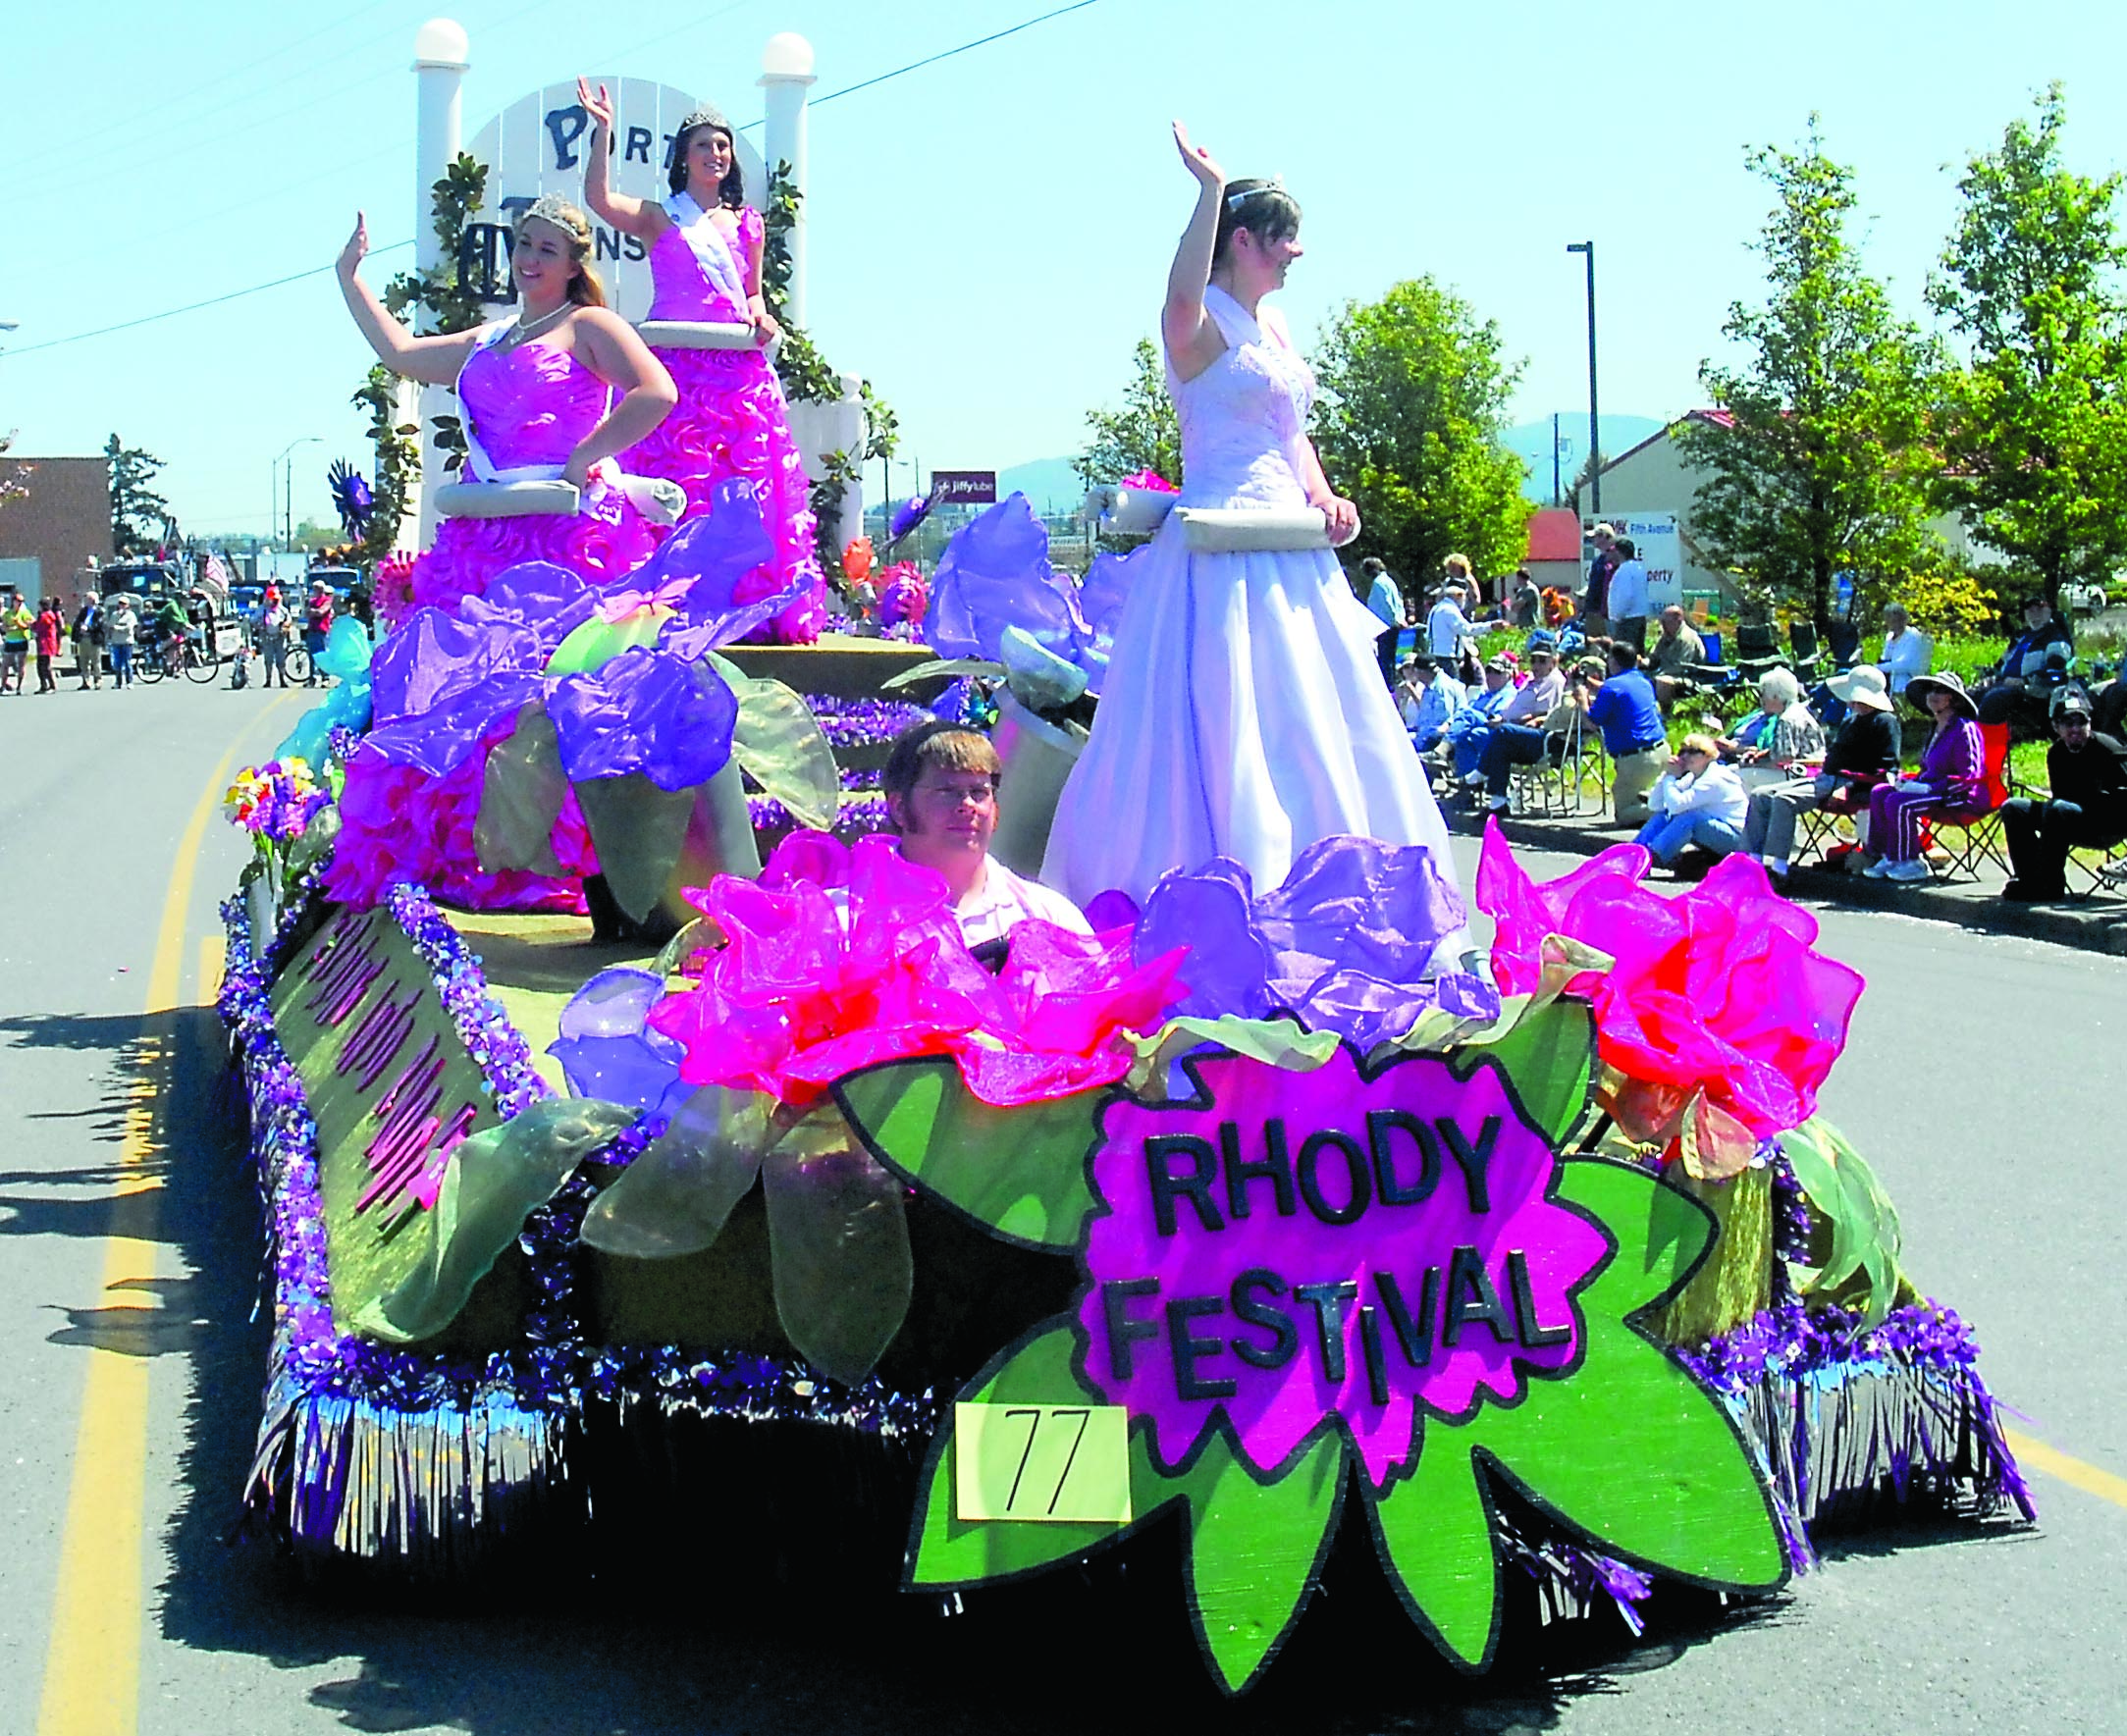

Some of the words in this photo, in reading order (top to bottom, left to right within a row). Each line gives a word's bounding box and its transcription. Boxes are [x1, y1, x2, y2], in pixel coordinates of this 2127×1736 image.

[1144, 1107, 1503, 1237] RHODY
[1100, 1244, 1572, 1407] FESTIVAL
[1003, 1408, 1091, 1515] 77
